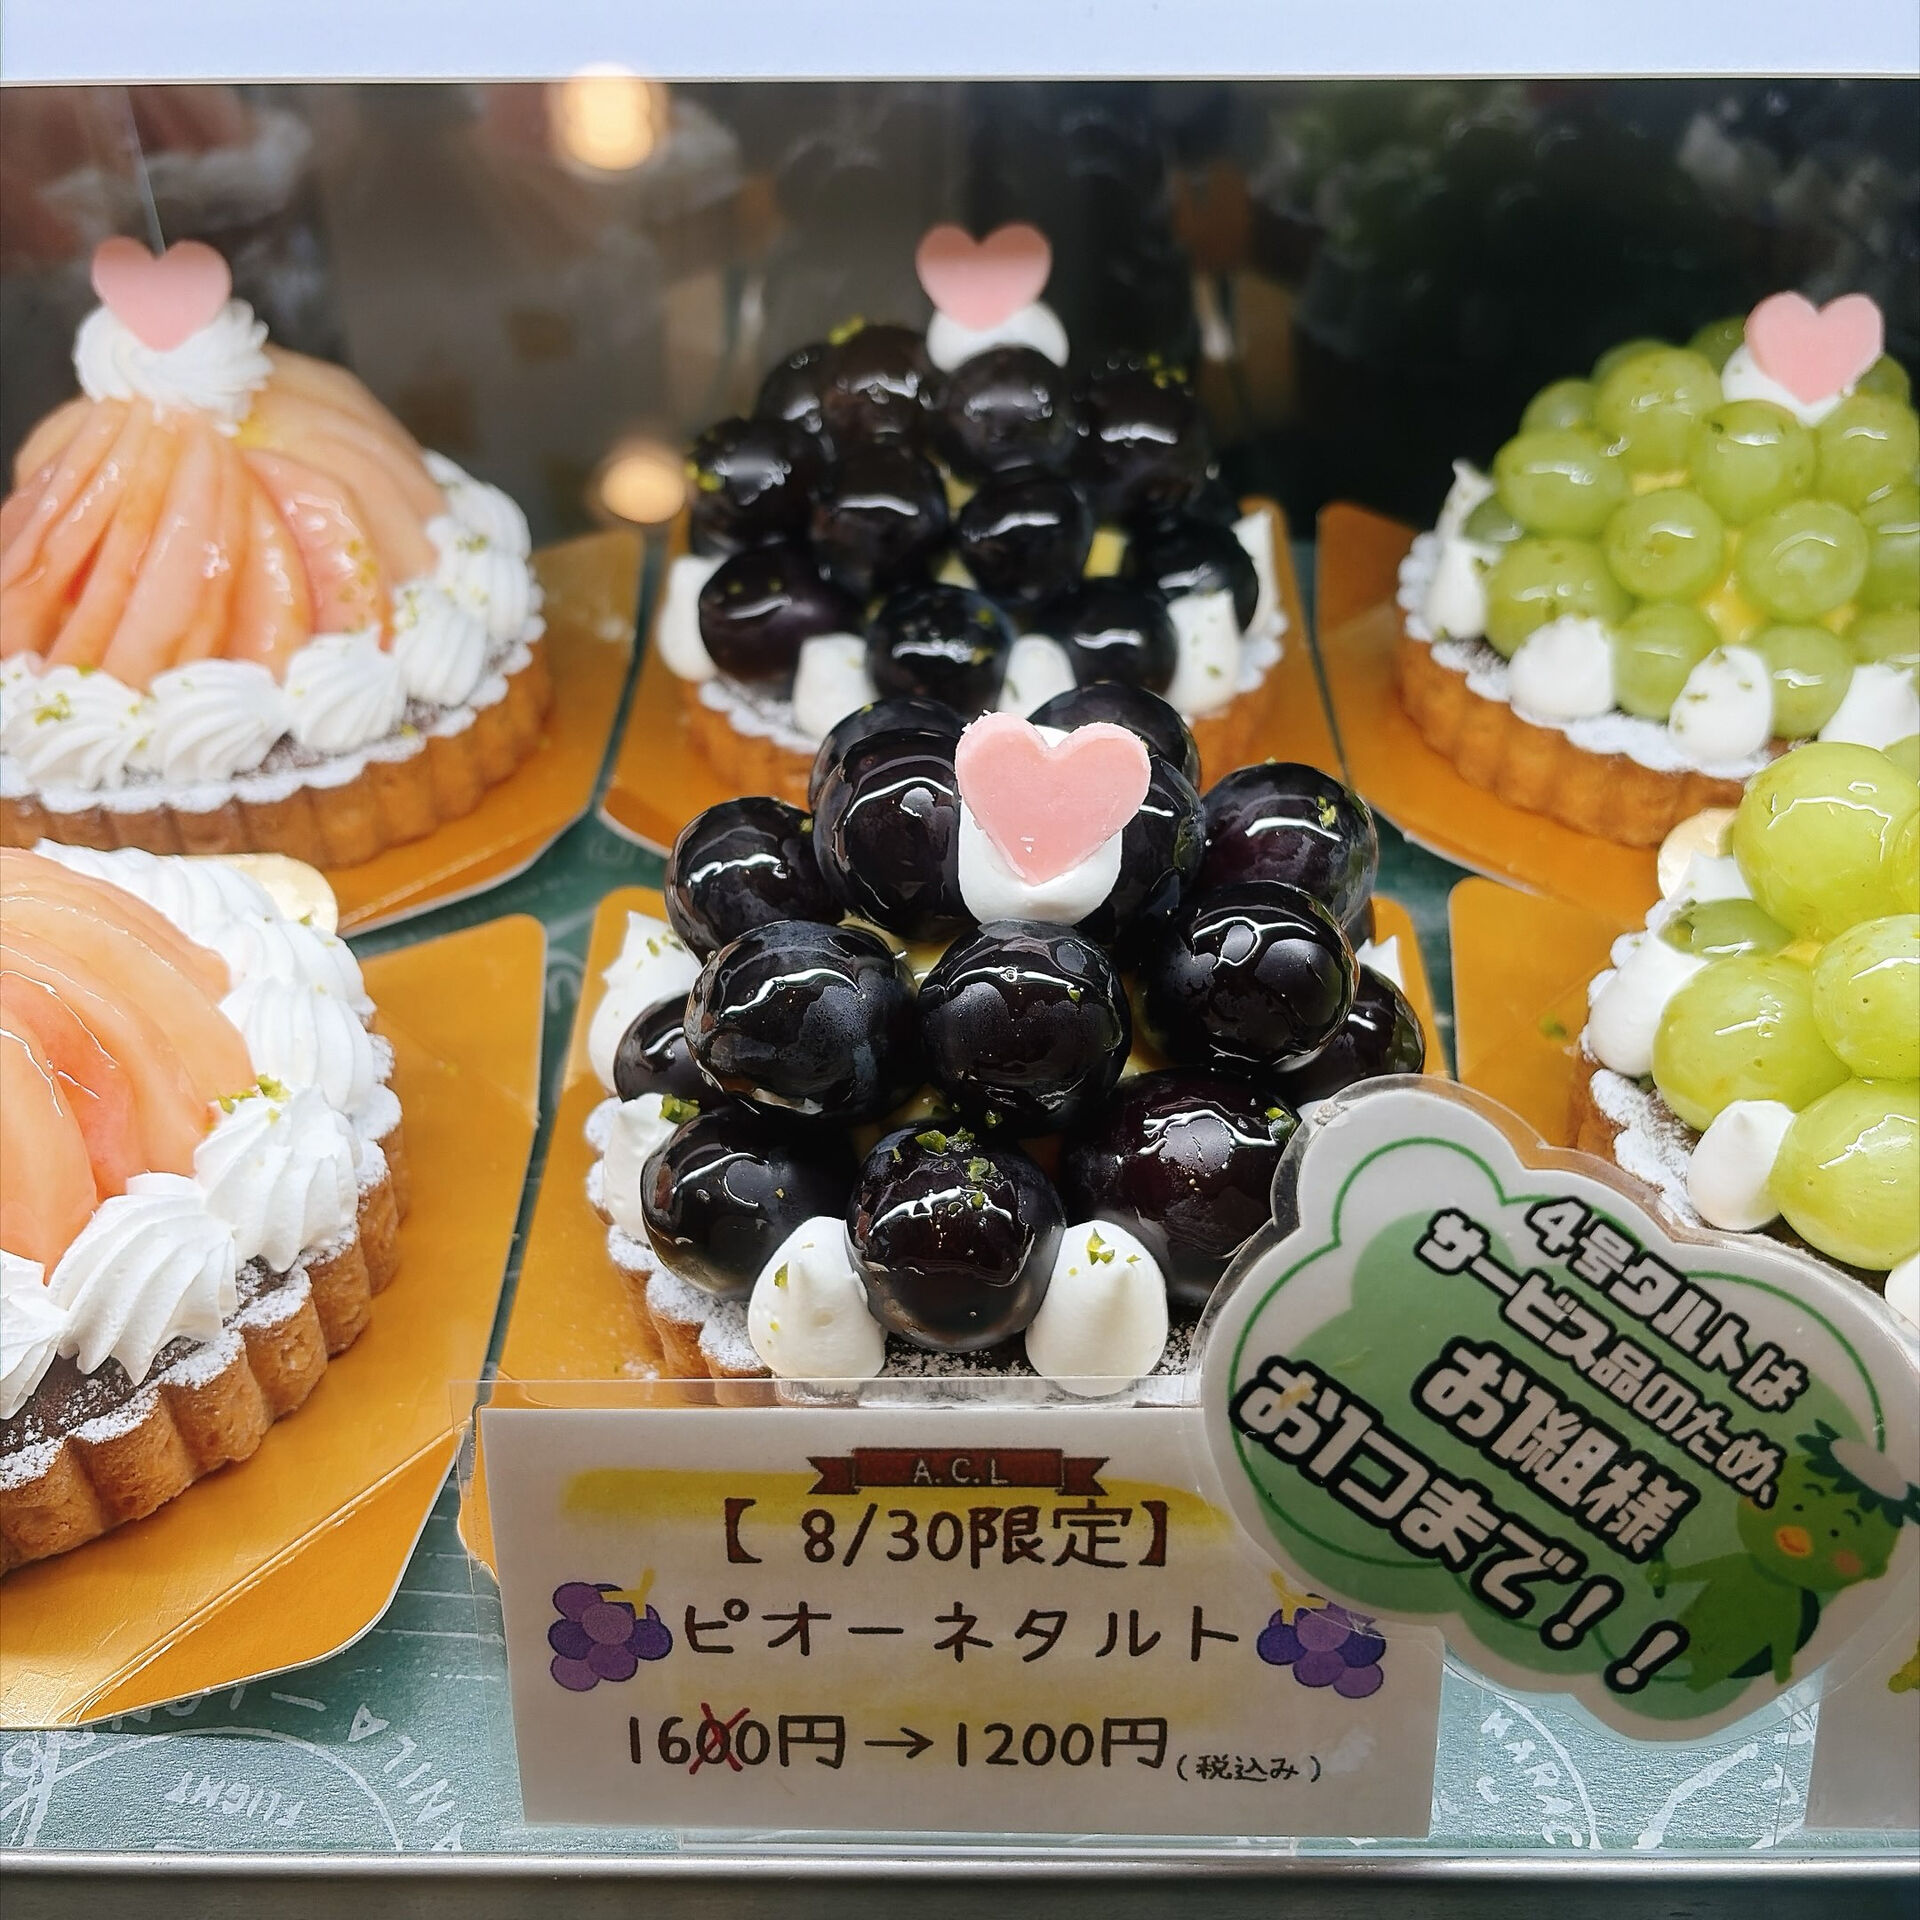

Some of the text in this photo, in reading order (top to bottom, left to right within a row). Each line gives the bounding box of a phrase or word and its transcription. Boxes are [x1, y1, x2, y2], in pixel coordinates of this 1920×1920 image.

[1415, 1209, 1787, 1508] サービス品のため、
[1527, 1198, 1807, 1411] 4号タルトは
[913, 1457, 1009, 1485] A.C.L
[1412, 1338, 1699, 1562] お1組様
[685, 1598, 1240, 1662] ピオーネタルト
[955, 1714, 1168, 1769] 1200円
[1176, 1753, 1322, 1783] (税込み)
